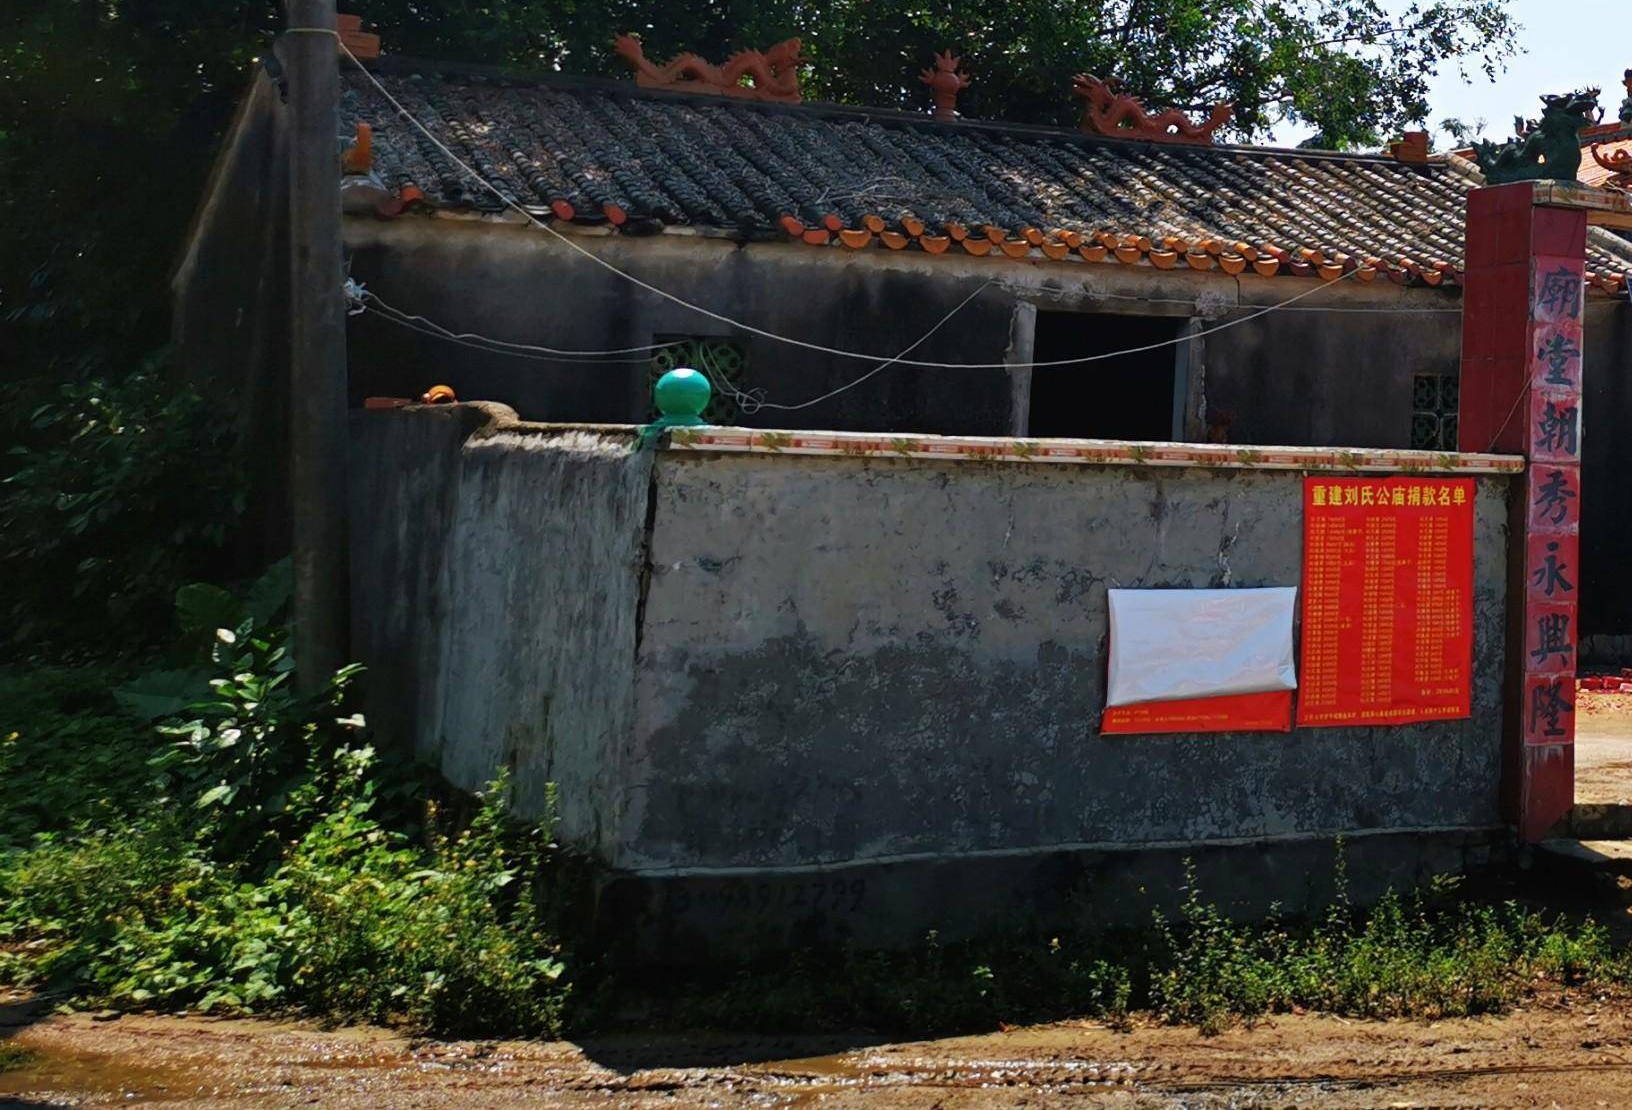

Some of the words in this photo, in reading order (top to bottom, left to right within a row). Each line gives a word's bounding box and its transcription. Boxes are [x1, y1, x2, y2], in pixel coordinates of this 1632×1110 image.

[1311, 485, 1467, 506] 重建刘氏公庙捐款名单
